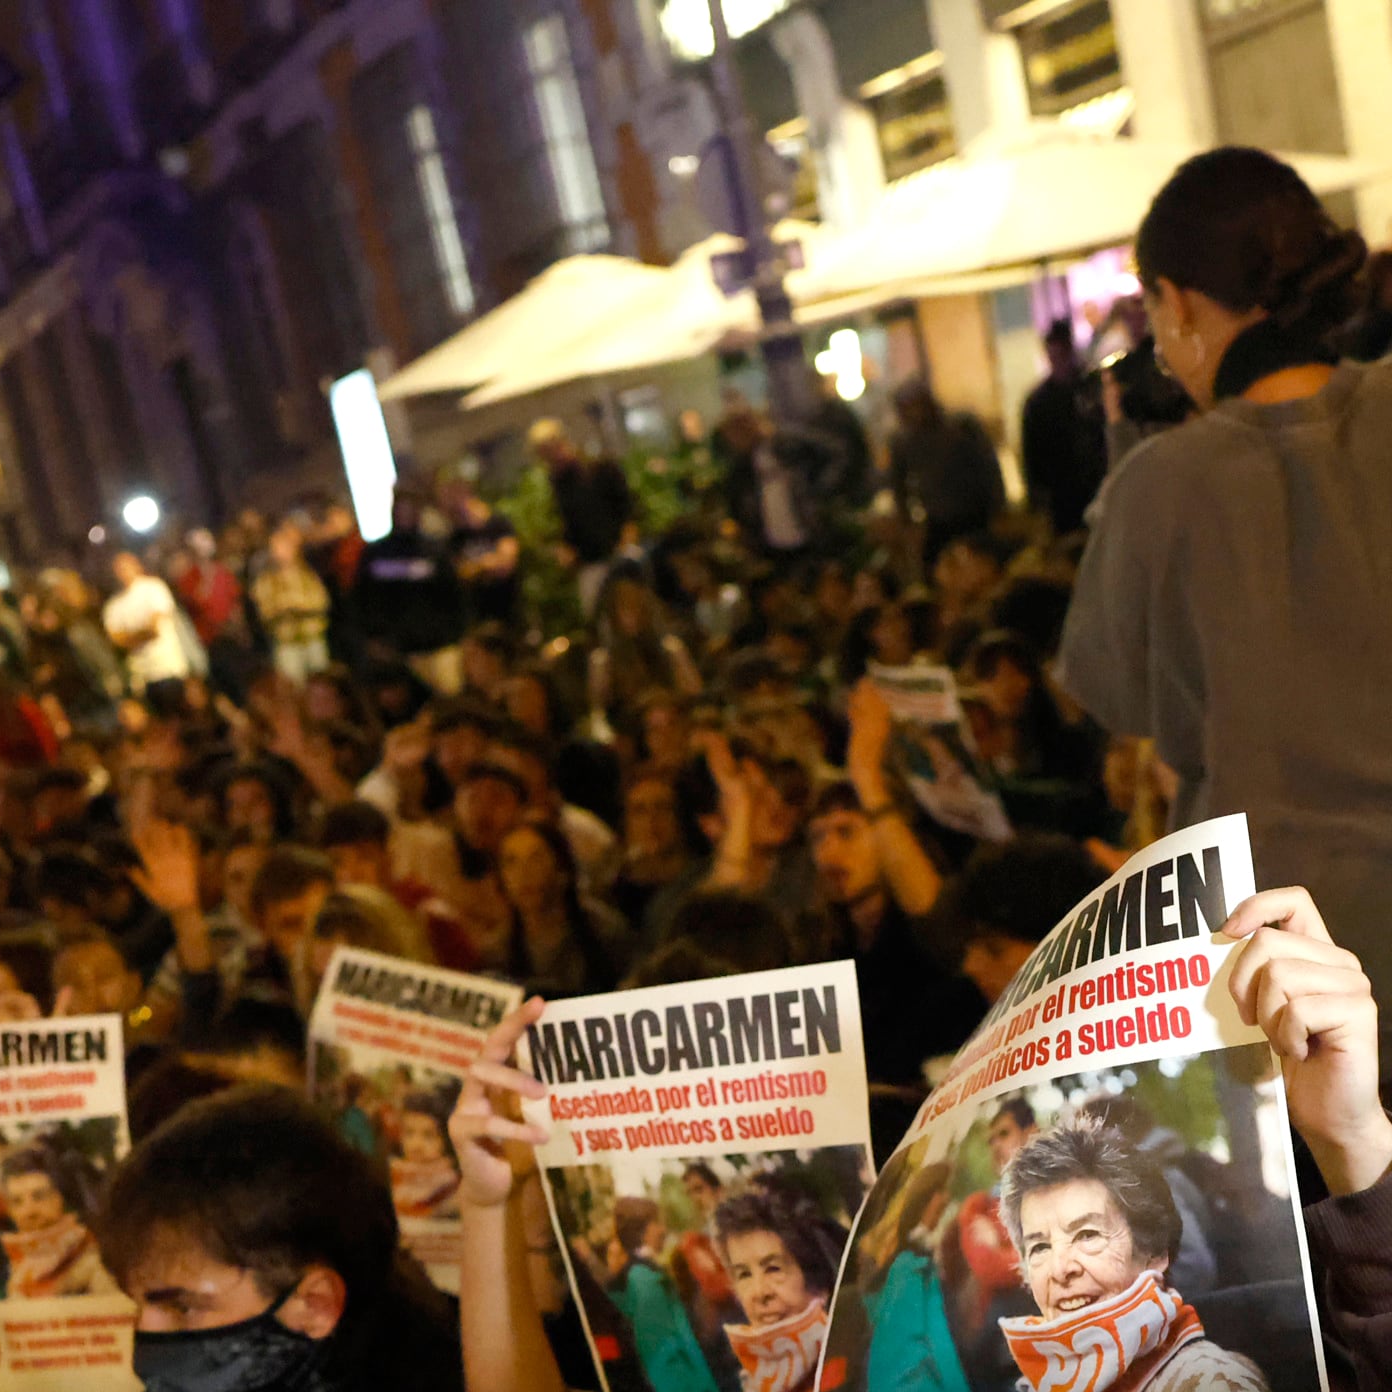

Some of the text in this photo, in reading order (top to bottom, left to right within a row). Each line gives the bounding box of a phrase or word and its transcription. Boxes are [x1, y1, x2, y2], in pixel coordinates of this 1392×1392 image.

[970, 845, 1229, 1040] ICARMEN
[527, 985, 842, 1085] MARICARMEN
[1005, 954, 1210, 1043] por el rentismo
[1055, 1029, 1072, 1061] a
[1077, 1003, 1192, 1056] sueldo
[549, 1069, 827, 1121] Asesinada por el rentismo
[571, 1106, 814, 1157] y sus políticos a sueldo
